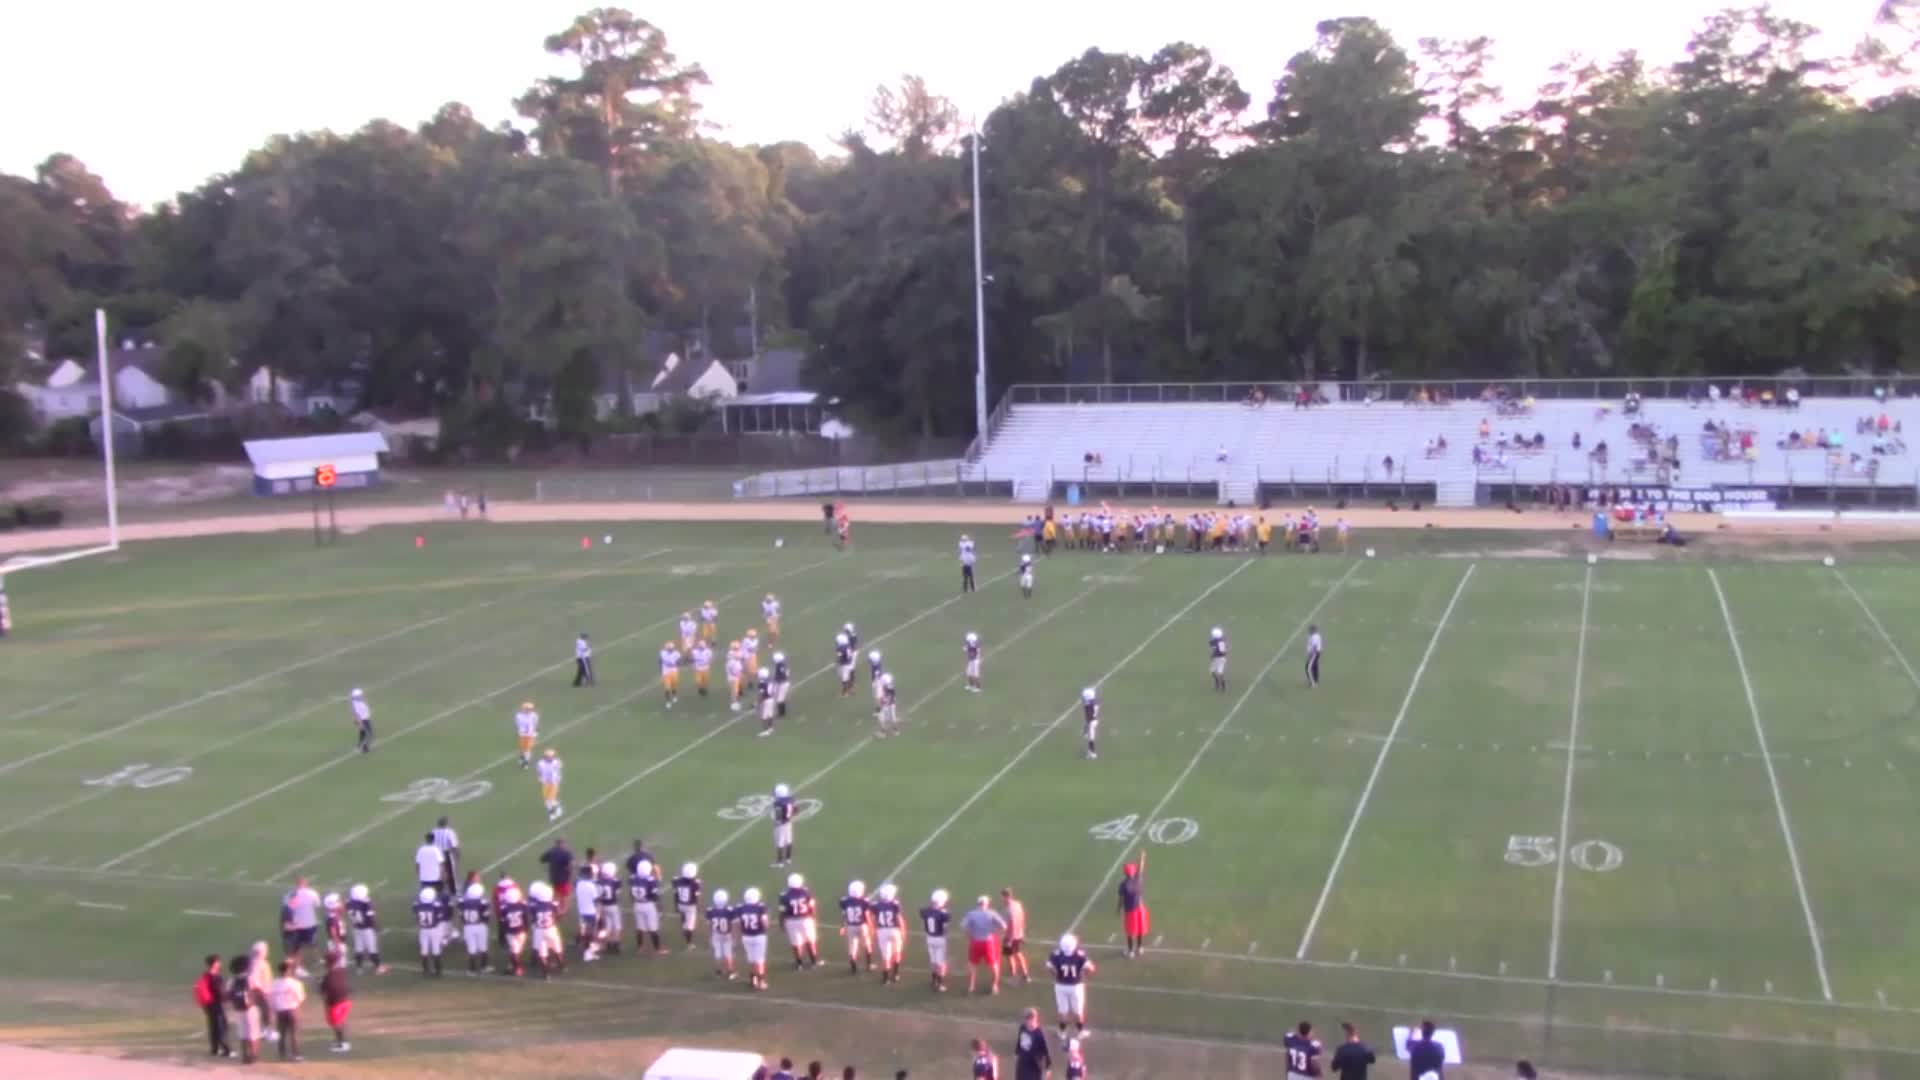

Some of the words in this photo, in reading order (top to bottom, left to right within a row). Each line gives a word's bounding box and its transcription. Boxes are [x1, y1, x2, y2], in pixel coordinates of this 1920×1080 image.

[1667, 490, 1690, 500] THE
[1694, 491, 1720, 501] DOG
[1088, 814, 1199, 844] 40
[1504, 835, 1622, 871] 50
[789, 898, 808, 915] 75
[741, 914, 758, 930] 72
[1061, 965, 1077, 978] 71
